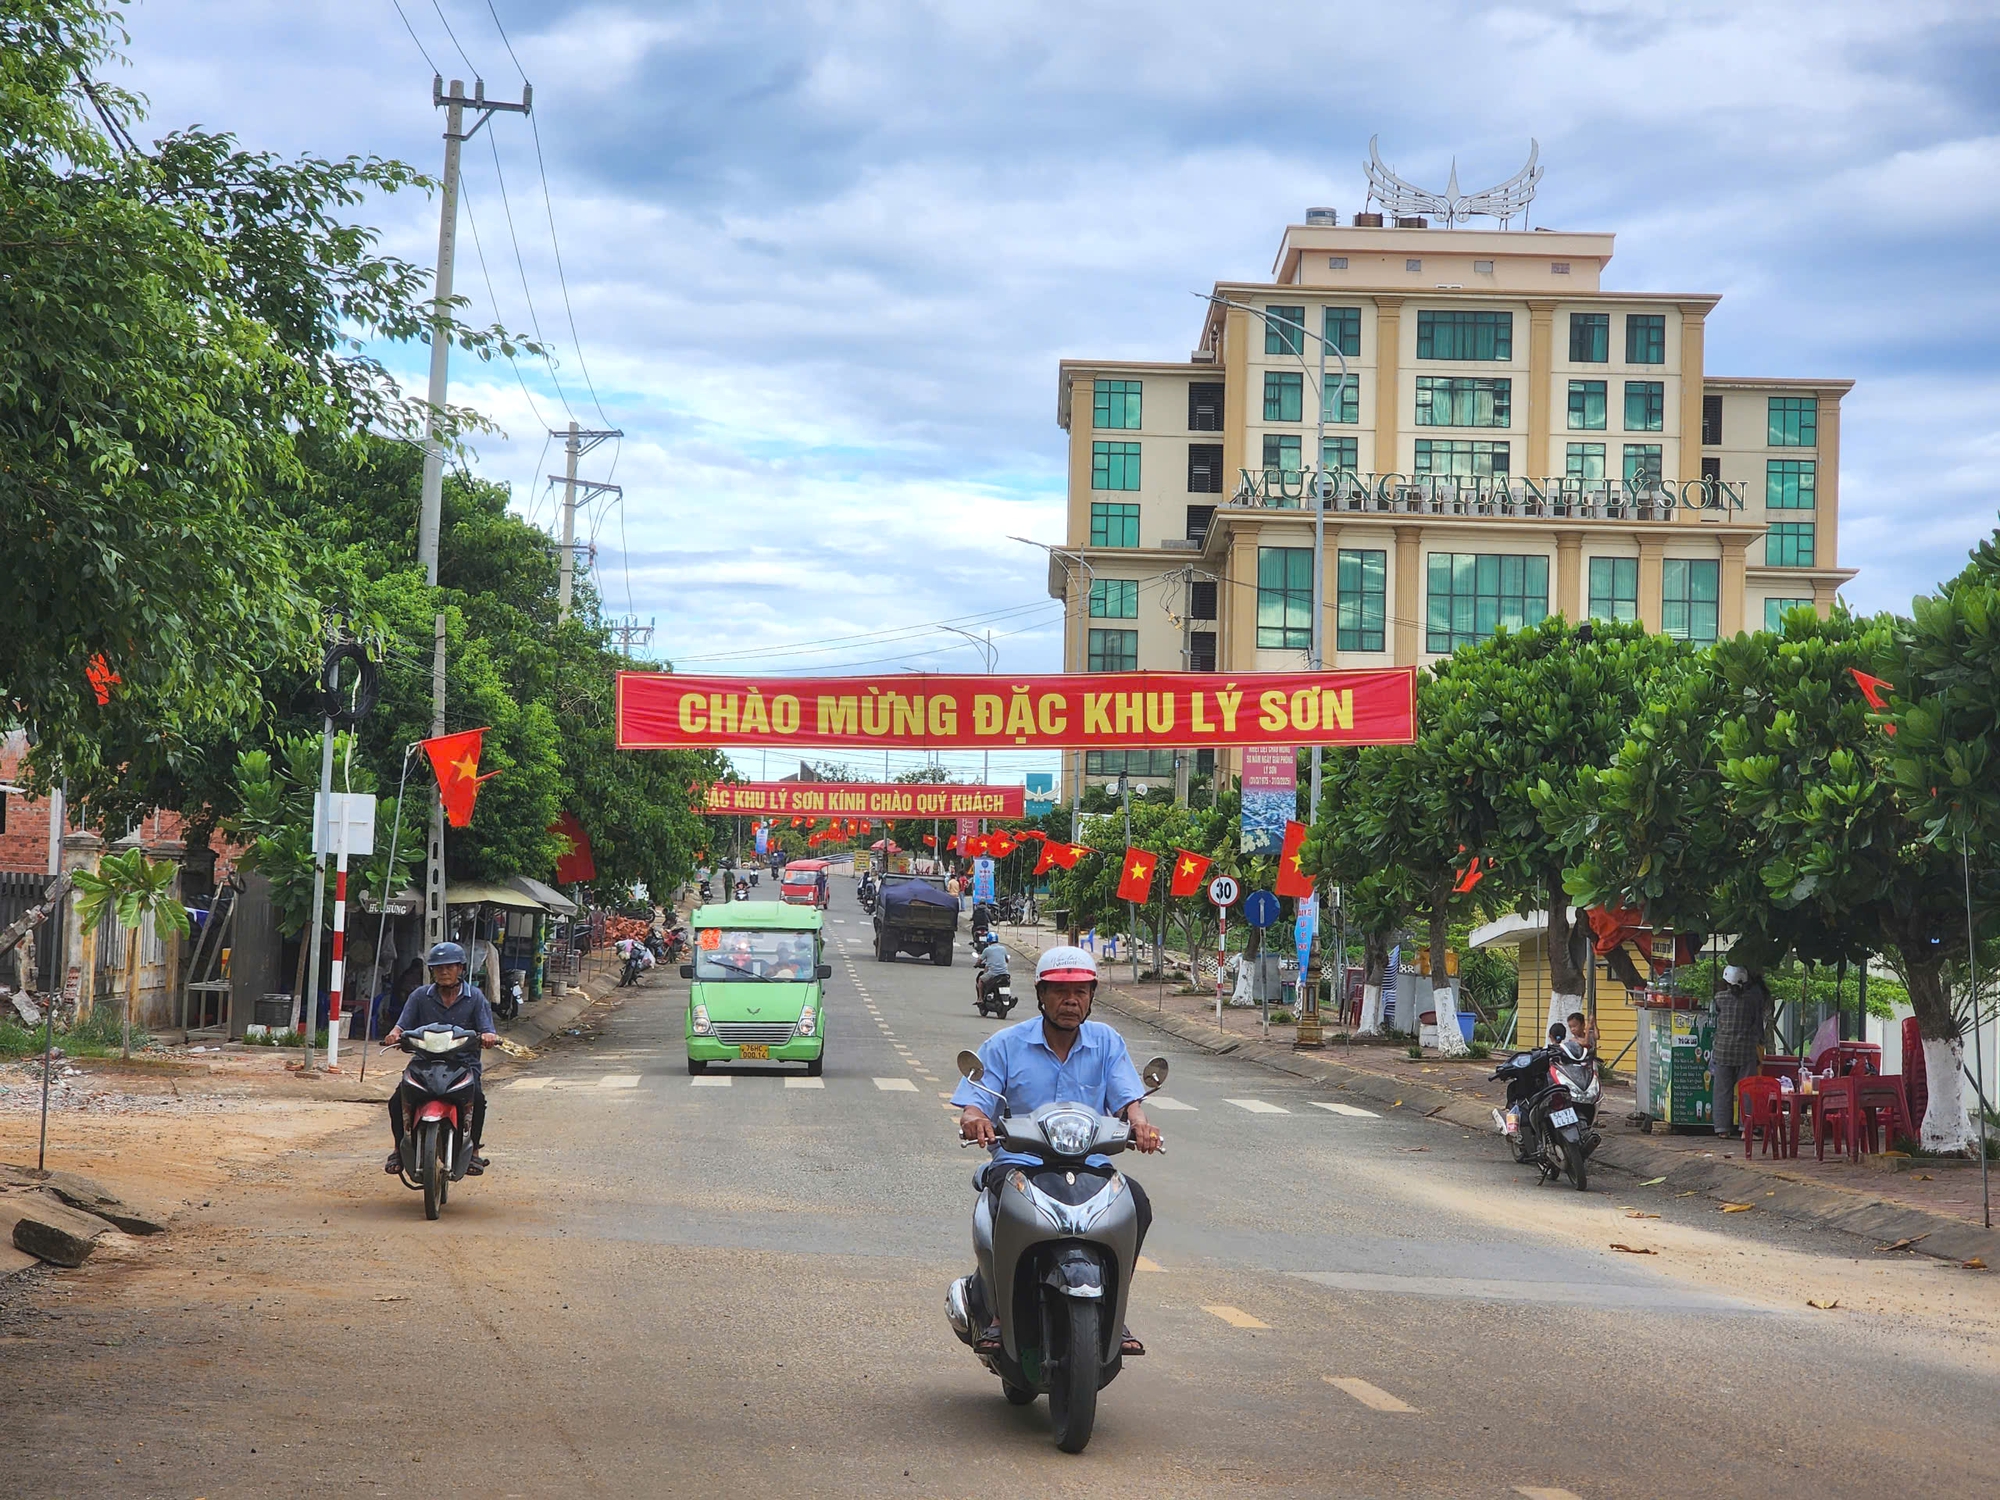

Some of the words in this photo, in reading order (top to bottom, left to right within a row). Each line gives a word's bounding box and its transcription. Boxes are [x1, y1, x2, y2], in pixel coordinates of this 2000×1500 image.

[1420, 472, 1588, 507] THANH
[1601, 467, 1650, 509] LÝ
[1657, 474, 1749, 511] SƠN
[679, 686, 800, 733] CHÀO
[817, 686, 957, 735] MỪNG
[973, 685, 1067, 744] ĐẶC
[1084, 692, 1175, 734] KHU
[1192, 683, 1243, 732] LÝ
[1259, 686, 1354, 731] SƠN
[734, 790, 765, 809] KHU
[769, 788, 787, 810] LÝ
[792, 790, 824, 810] SƠN
[828, 789, 866, 811] KÍNH
[870, 790, 912, 812] CHÀO
[916, 791, 947, 814] QUÝ
[951, 791, 1004, 812] KHÁCH
[1216, 881, 1231, 900] 30
